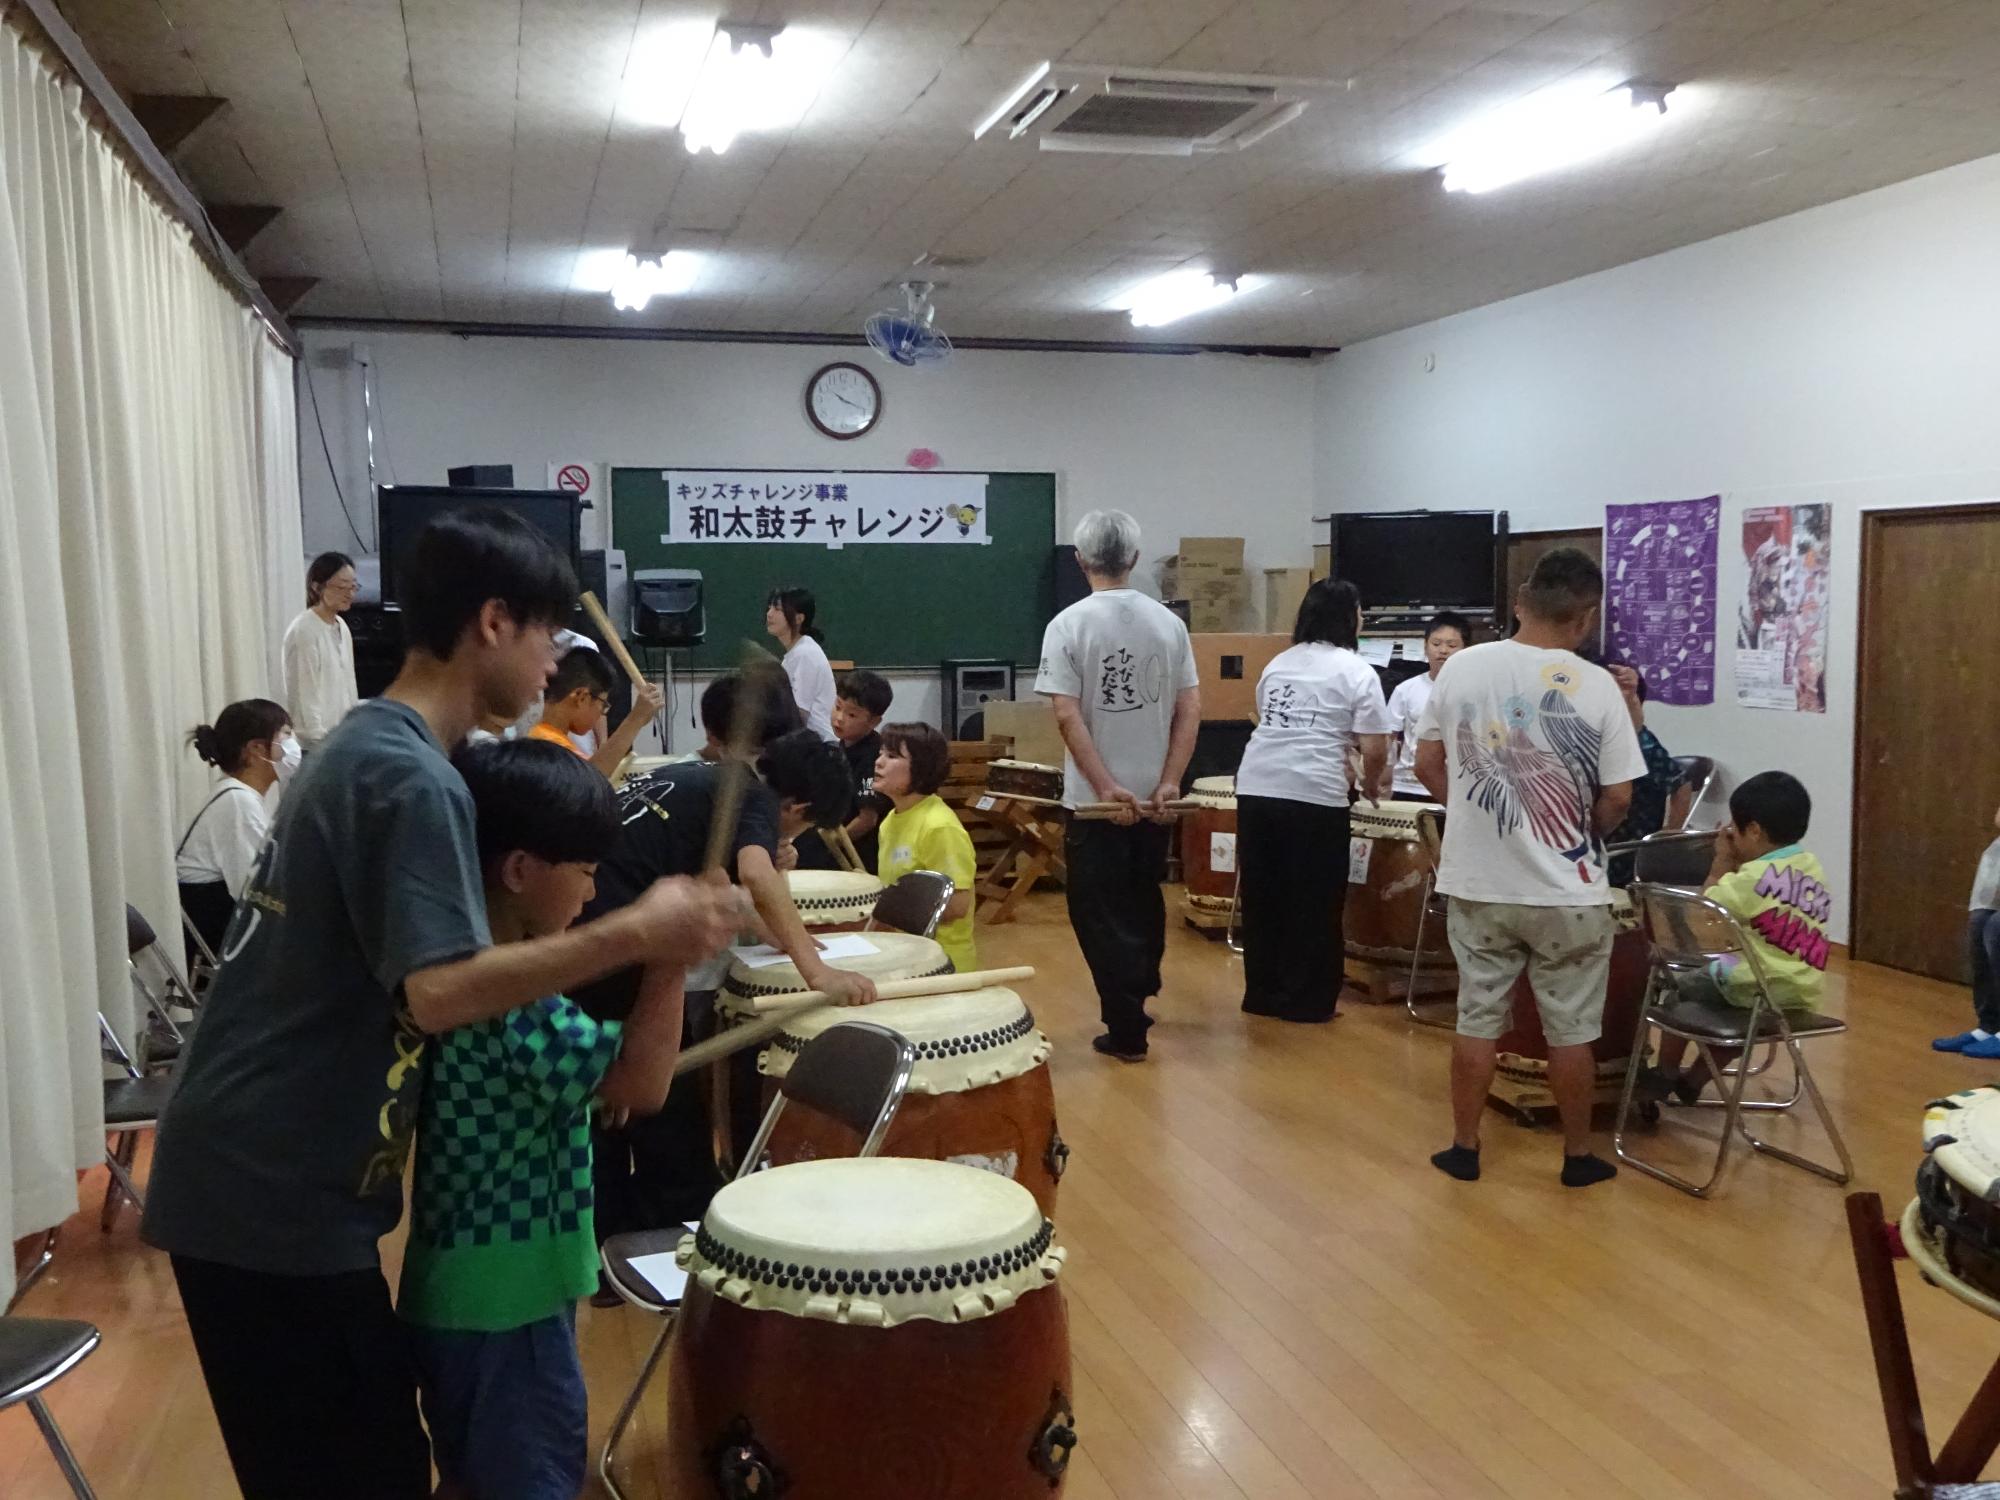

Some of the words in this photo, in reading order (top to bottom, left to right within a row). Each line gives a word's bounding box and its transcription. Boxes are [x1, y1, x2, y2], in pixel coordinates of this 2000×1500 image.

[677, 483, 848, 502] キッズチャレンジ事業
[689, 505, 944, 538] 和太鼓チャレンジ
